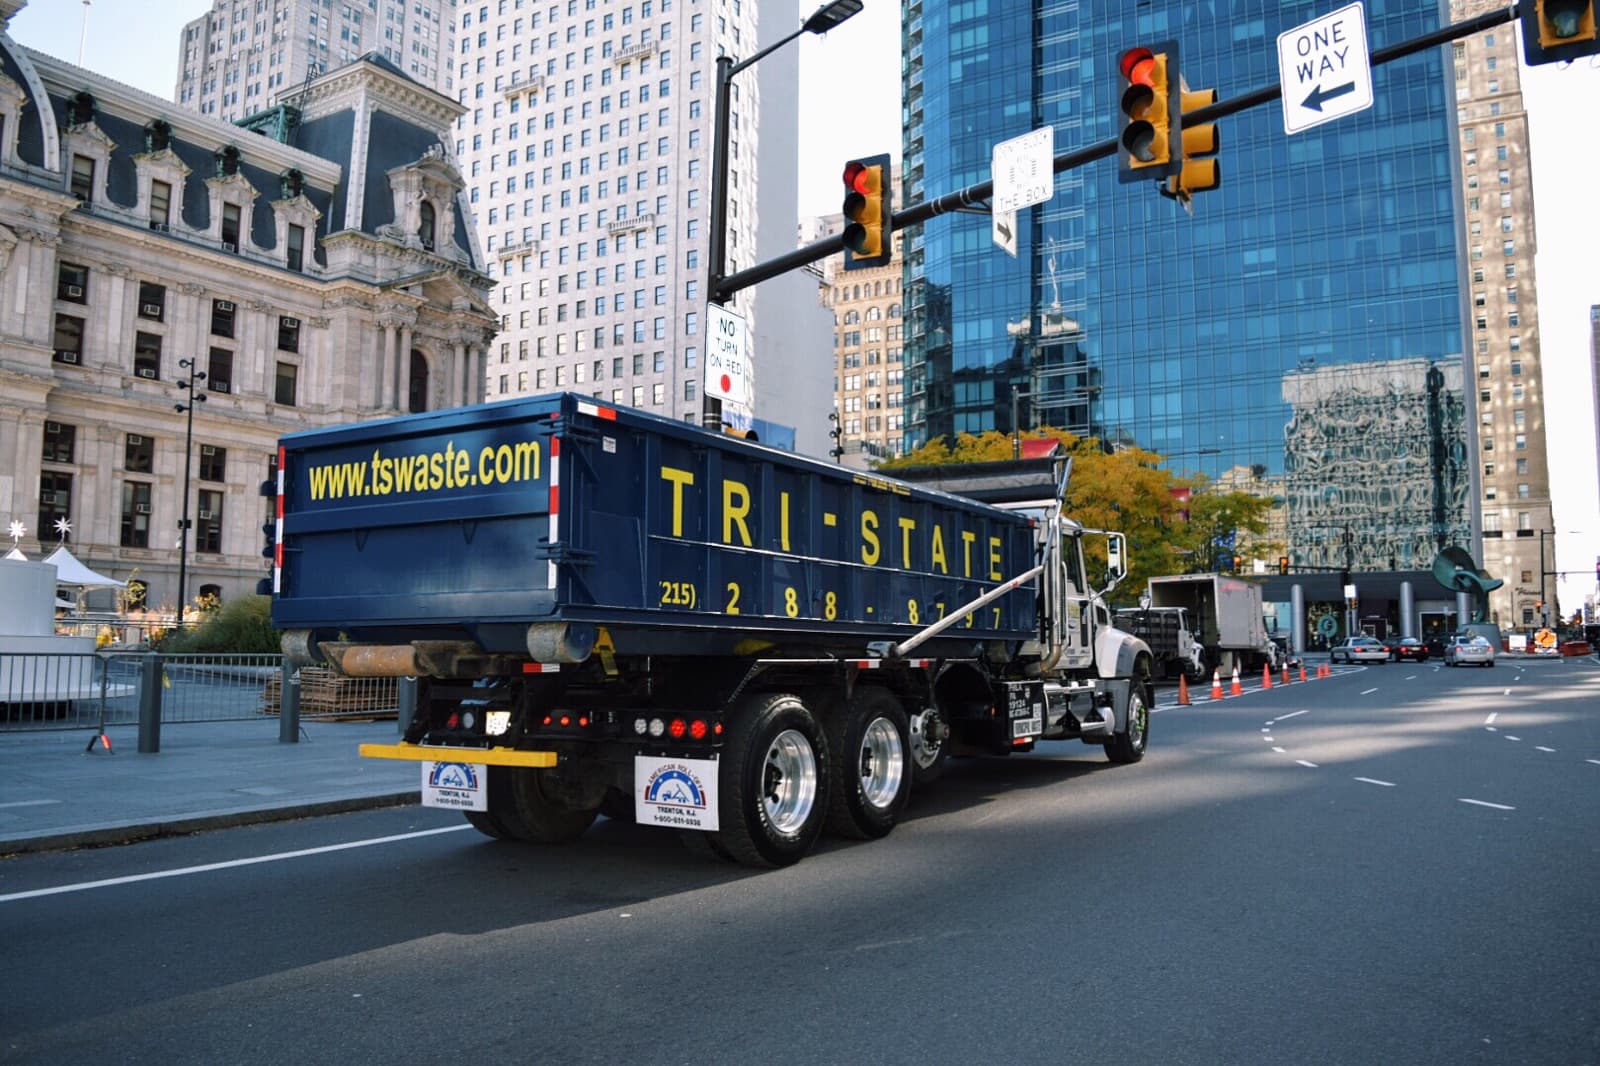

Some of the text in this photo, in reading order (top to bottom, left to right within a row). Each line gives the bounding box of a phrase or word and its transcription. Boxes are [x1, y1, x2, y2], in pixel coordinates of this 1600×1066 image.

[1297, 20, 1346, 56] ONE
[1297, 44, 1349, 84] WAY
[1000, 184, 1047, 210] THE BOX
[720, 317, 736, 337] NO
[716, 337, 738, 356] TURN
[710, 353, 742, 375] ON RED
[309, 440, 540, 500] www.tswaste.com
